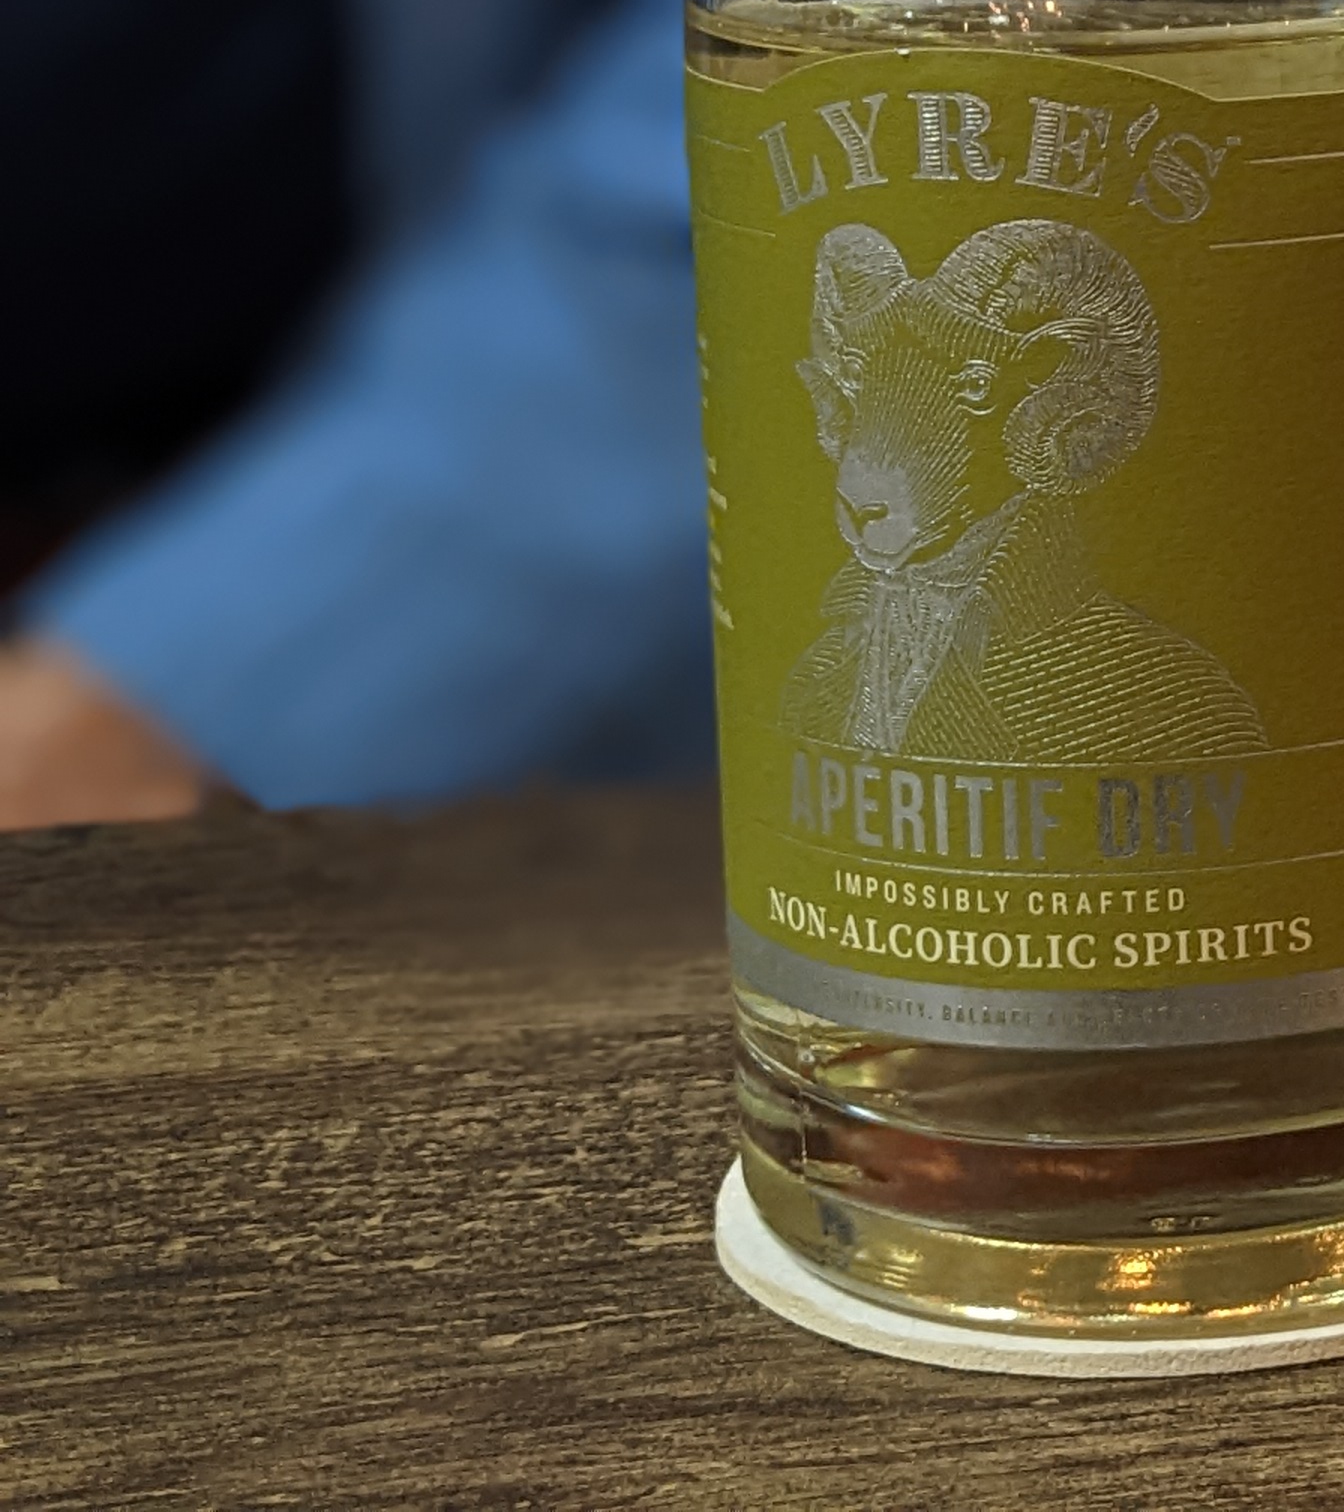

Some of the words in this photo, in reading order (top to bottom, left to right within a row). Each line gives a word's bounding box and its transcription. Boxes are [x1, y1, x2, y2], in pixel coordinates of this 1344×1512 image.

[758, 91, 1227, 224] LYRE'S
[790, 750, 1064, 861] APÉRITIF
[1096, 766, 1246, 859] DRY
[768, 885, 1096, 970] NON-ALCOHOLIC
[1113, 916, 1313, 969] SPIRITS
[834, 869, 1009, 916] IMPOSSIBLY
[1027, 887, 1186, 916] CRAFTED
